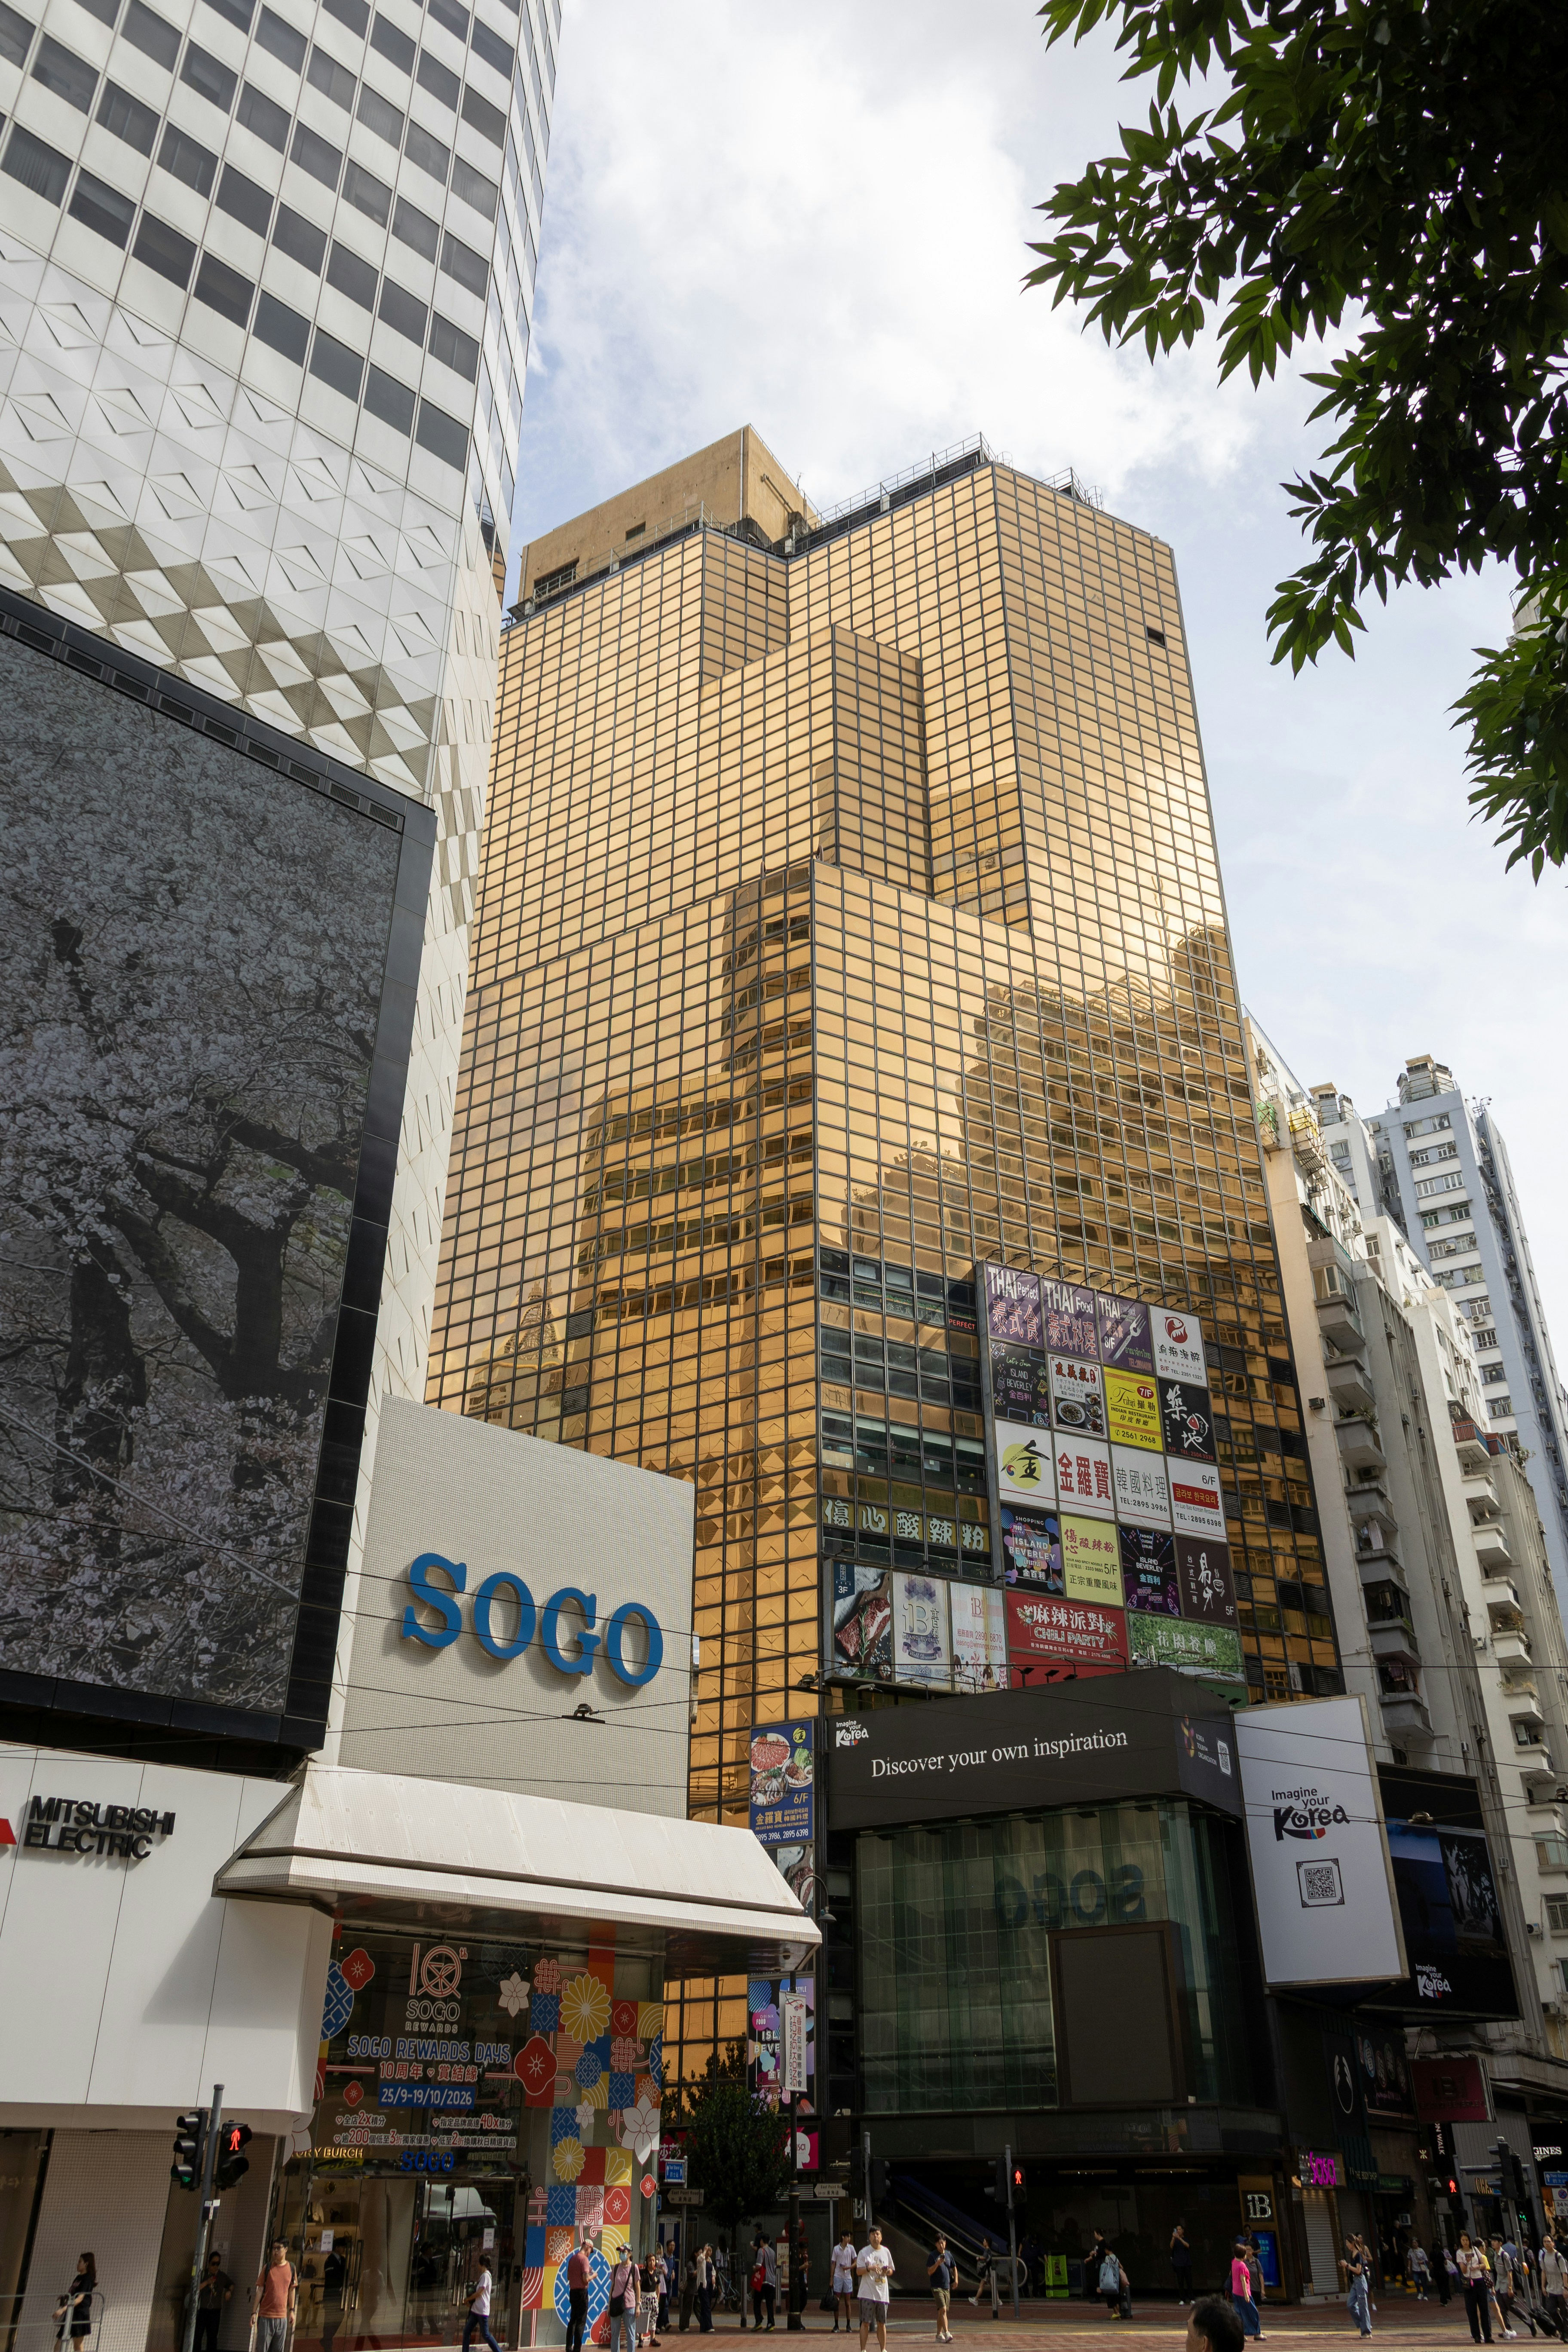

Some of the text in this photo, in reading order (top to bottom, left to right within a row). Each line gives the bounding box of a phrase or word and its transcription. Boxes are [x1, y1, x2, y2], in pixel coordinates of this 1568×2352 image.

[988, 1267, 1038, 1300] THAI Perfect
[1044, 1281, 1093, 1314] THAI Food
[886, 1303, 912, 1315] 泰式食
[1099, 1298, 1121, 1319] THAI
[949, 1319, 975, 1330] PERFECT
[992, 1298, 1038, 1343] 泰式食
[1048, 1311, 1096, 1355] 泰式料理
[1104, 1336, 1115, 1349] 8/F
[1011, 1368, 1028, 1379] ISLAND
[1007, 1378, 1032, 1391] BEVERLEY
[1009, 1390, 1031, 1402] 金百利
[1110, 1385, 1136, 1407] Tulsi
[1139, 1387, 1152, 1397] 7/F
[1137, 1399, 1155, 1412] 羅勒
[1120, 1414, 1149, 1426] 印度餐廳
[1128, 1411, 1156, 1421] RESTAURANT
[1121, 1430, 1156, 1444] 2561 2968
[1058, 1452, 1111, 1501] 金羅寶
[1116, 1467, 1167, 1500] 韓國料理
[1202, 1475, 1216, 1485] 6/F
[1176, 1488, 1216, 1505] 금라보 한국요리
[1151, 1503, 1167, 1512] 3986
[825, 1499, 984, 1551] 傷心酸辣粉
[1015, 1516, 1044, 1525] SHOPPING
[1191, 1516, 1222, 1527] 2895 6398
[1015, 1537, 1048, 1550] ISLAND
[1009, 1546, 1056, 1562] BEVERLEY
[1139, 1556, 1158, 1565] ISLAND
[1023, 1569, 1045, 1580] 金百利
[1104, 1563, 1117, 1575] 5/F
[1136, 1562, 1163, 1573] BEVERLEY
[1069, 1574, 1118, 1591] 正宗重慶風味
[1139, 1574, 1161, 1585] 金百利
[1187, 1555, 1197, 1603] 台式料理
[1225, 1605, 1234, 1616] 5F
[403, 1553, 663, 1687] SOGO
[1033, 1604, 1104, 1633] 麻辣派對
[975, 1631, 987, 1641] 2890
[990, 1633, 1001, 1643] 6870
[1067, 1632, 1105, 1648] PARTY
[956, 1638, 1003, 1652] leasing@winnings.com.hk
[918, 1666, 932, 1675] 2890
[836, 1728, 869, 1747] Korea
[871, 1729, 1128, 1777] Discover your own inspiration
[1198, 1752, 1217, 1766] ORGANIZATION
[794, 1793, 808, 1804] 6/F
[1272, 1787, 1317, 1801] Imagine
[1302, 1796, 1329, 1809] your
[29, 1795, 176, 1835] MITSUBISHI
[756, 1810, 782, 1825] 金羅寶
[784, 1813, 808, 1822] 韓國料理
[1274, 1804, 1351, 1841] Korea
[24, 1823, 152, 1859] ELECTRIC
[768, 1828, 808, 1840] 3986, 2895 6398
[1415, 1963, 1436, 1973] Imagine
[1417, 1975, 1452, 1997] Korea
[406, 1999, 460, 2021] SOGO
[405, 2022, 458, 2034] REWARDS
[347, 2036, 511, 2063] SOGO REWARDS DAYS
[380, 2061, 478, 2082] 10周年 賞結緣
[381, 2087, 472, 2105] 25/9-19/10/2026
[343, 2110, 386, 2126] 全店2x積分
[440, 2113, 513, 2130] 指定品牌高達40x積分
[341, 2128, 430, 2146] 逾200個低至3折獨家優惠
[438, 2131, 516, 2148] 低至2折換購秋日精選貨品
[1437, 2134, 1445, 2155] WALK
[324, 2147, 364, 2158] BURCH
[401, 2150, 454, 2172] SOGO
[1247, 2194, 1271, 2218] iB
